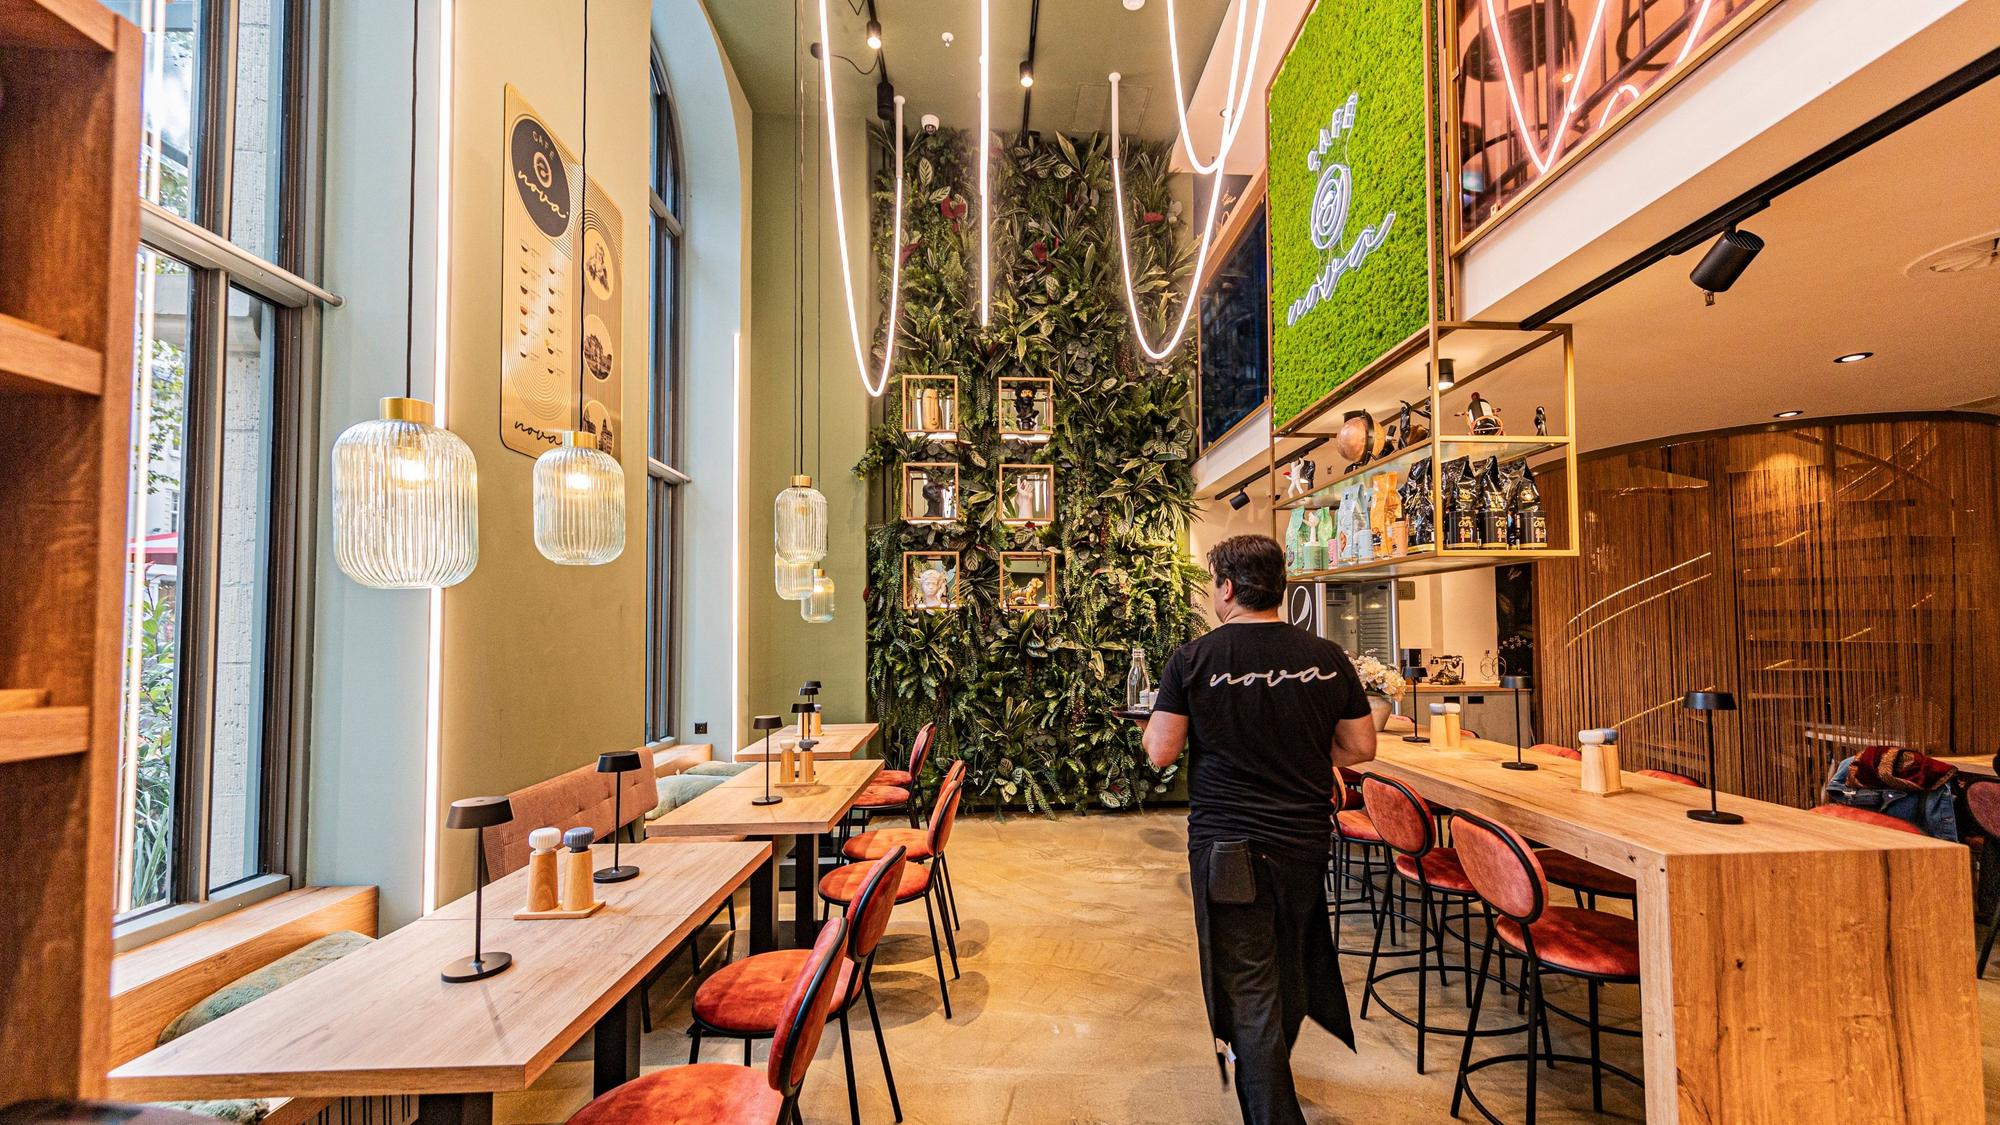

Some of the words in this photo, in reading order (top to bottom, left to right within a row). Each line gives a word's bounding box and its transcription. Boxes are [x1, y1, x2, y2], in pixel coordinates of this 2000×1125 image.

[517, 170, 567, 219] nova
[1287, 210, 1397, 328] nova
[514, 420, 563, 446] nova
[1209, 666, 1338, 688] nova
